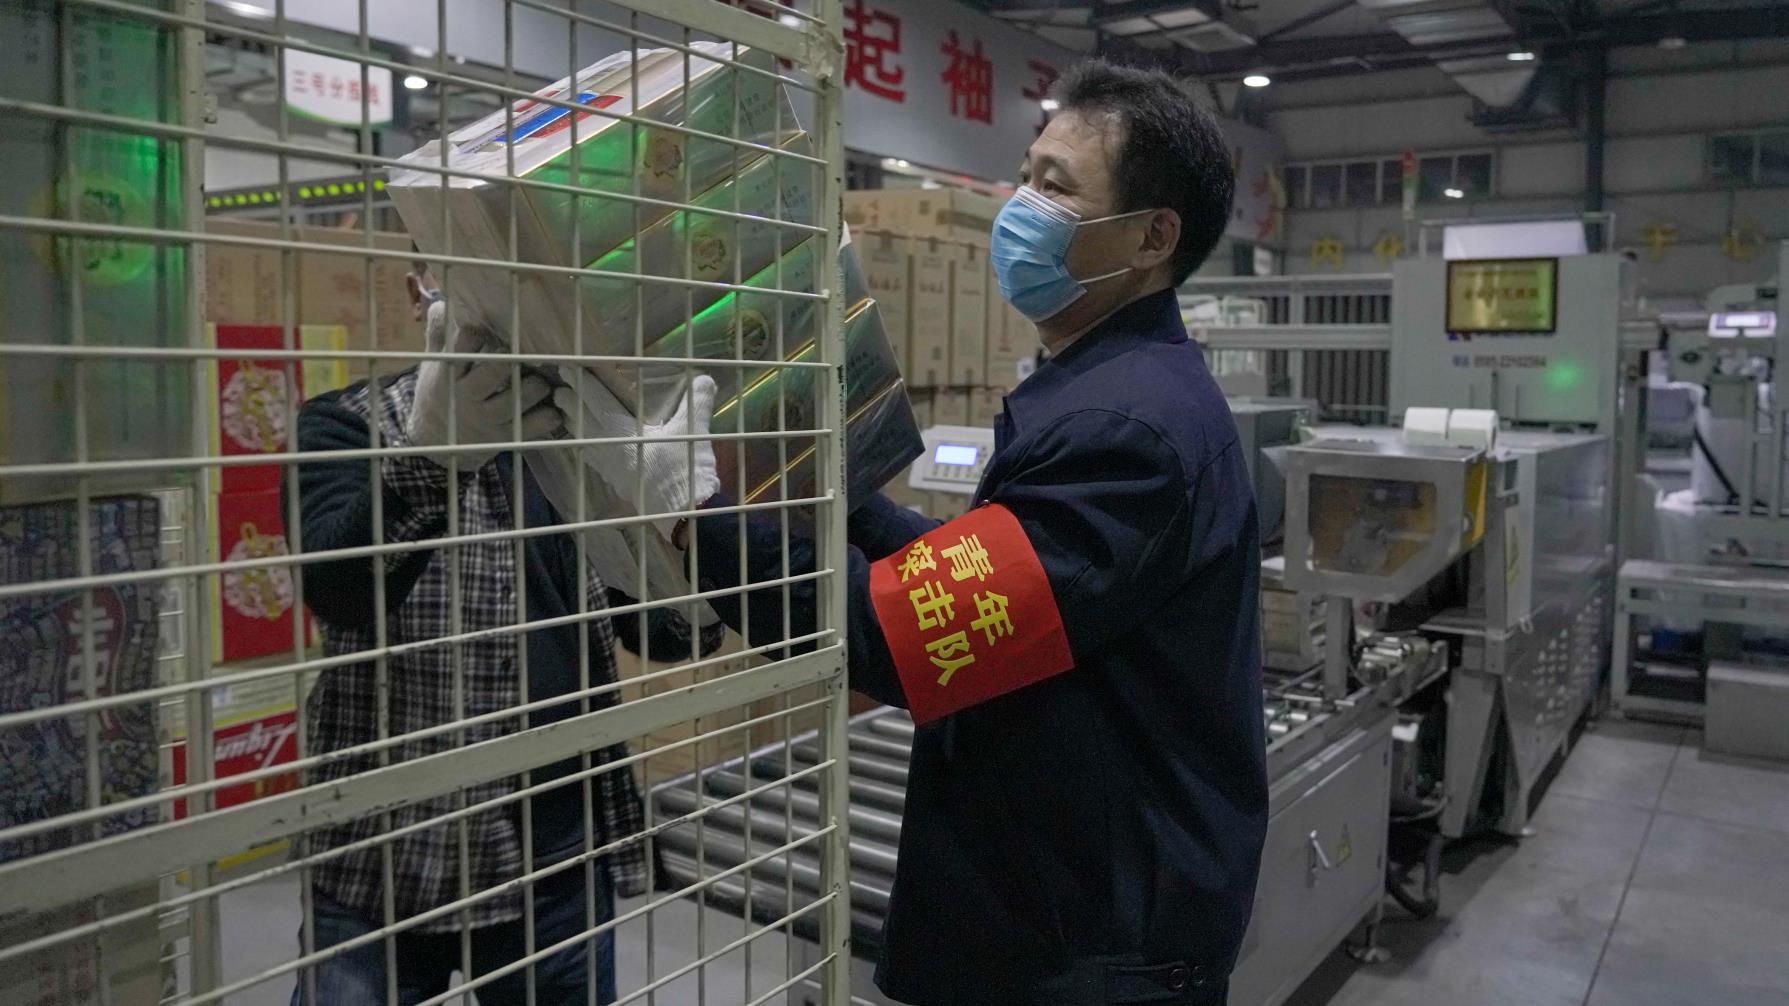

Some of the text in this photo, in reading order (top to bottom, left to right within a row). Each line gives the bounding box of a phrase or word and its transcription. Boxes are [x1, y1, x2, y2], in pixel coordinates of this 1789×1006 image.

[897, 540, 976, 687] 突击队
[940, 533, 1015, 647] 青年
